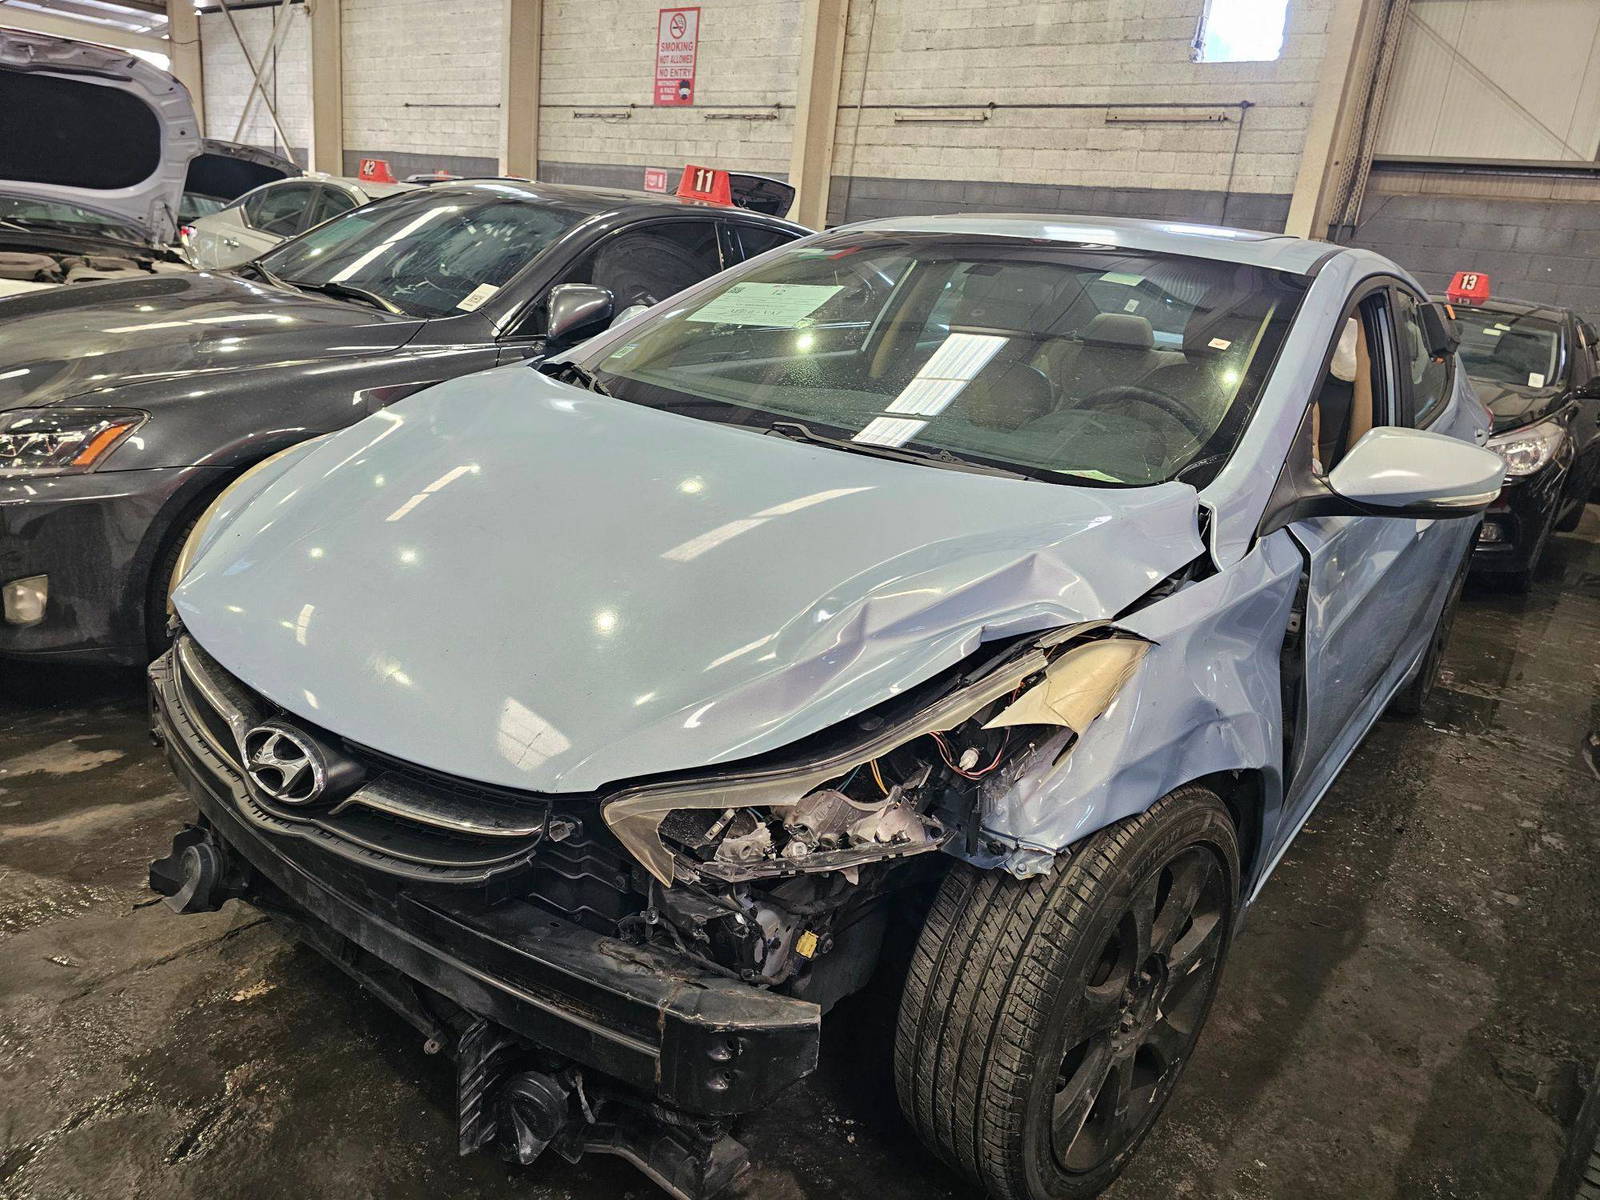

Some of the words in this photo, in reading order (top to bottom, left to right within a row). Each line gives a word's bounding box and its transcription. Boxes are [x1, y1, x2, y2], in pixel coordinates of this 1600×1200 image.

[660, 41, 693, 52] SMOKING
[660, 55, 669, 64] NOT
[670, 54, 693, 64] ALLOWED
[659, 68, 669, 77] NO
[670, 68, 692, 77] ENTRY
[696, 169, 713, 193] 11
[1461, 274, 1478, 290] 13
